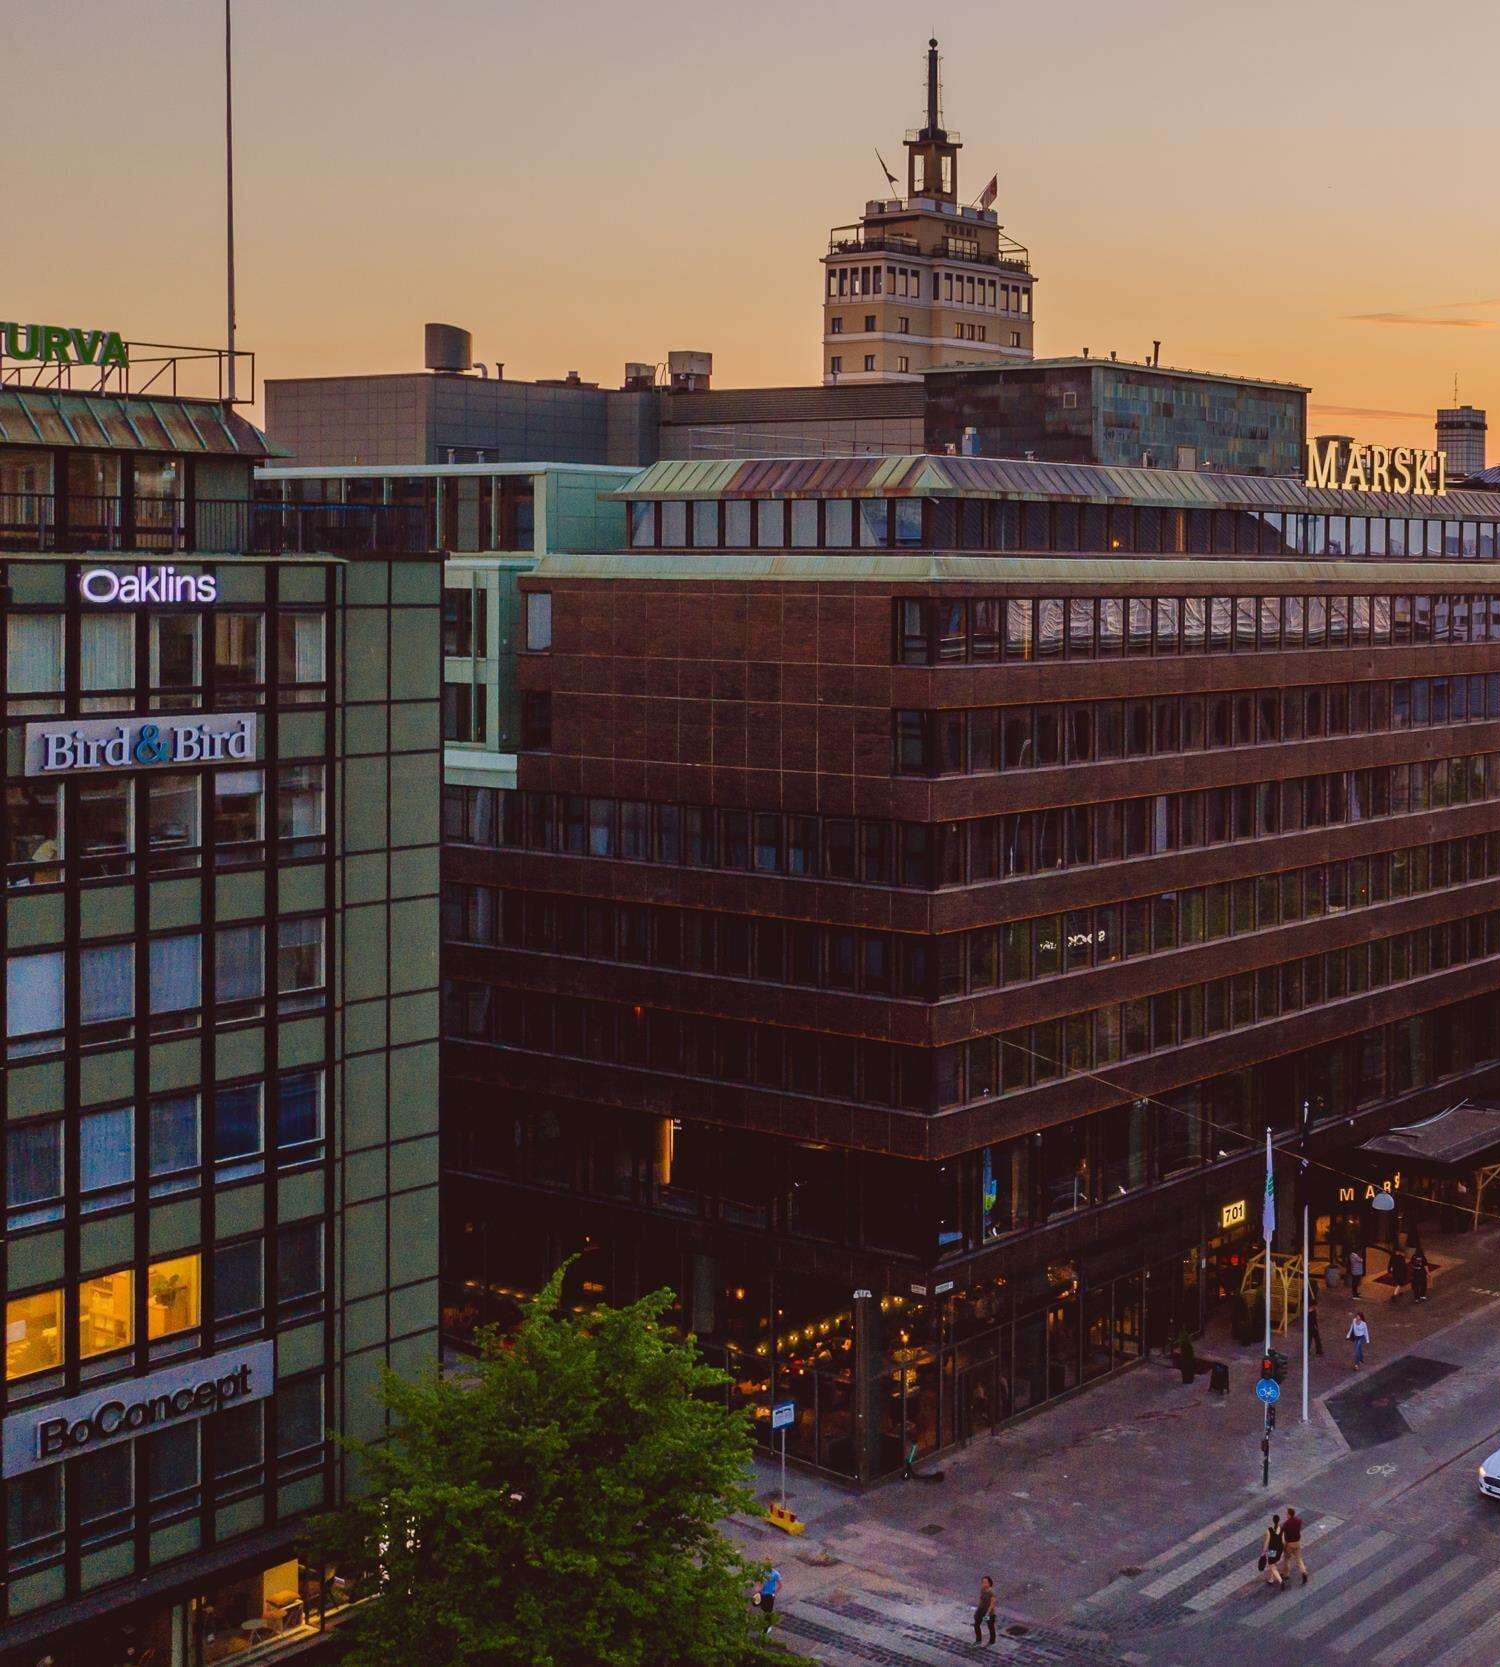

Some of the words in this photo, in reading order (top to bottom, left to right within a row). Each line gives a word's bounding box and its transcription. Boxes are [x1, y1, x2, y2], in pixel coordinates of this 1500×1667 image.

[1306, 438, 1447, 497] MARSKI
[80, 566, 217, 603] Oaklins
[43, 726, 132, 771] Bird
[171, 720, 251, 763] Bird
[1224, 1205, 1244, 1223] 701
[37, 1363, 252, 1459] BoConcept
